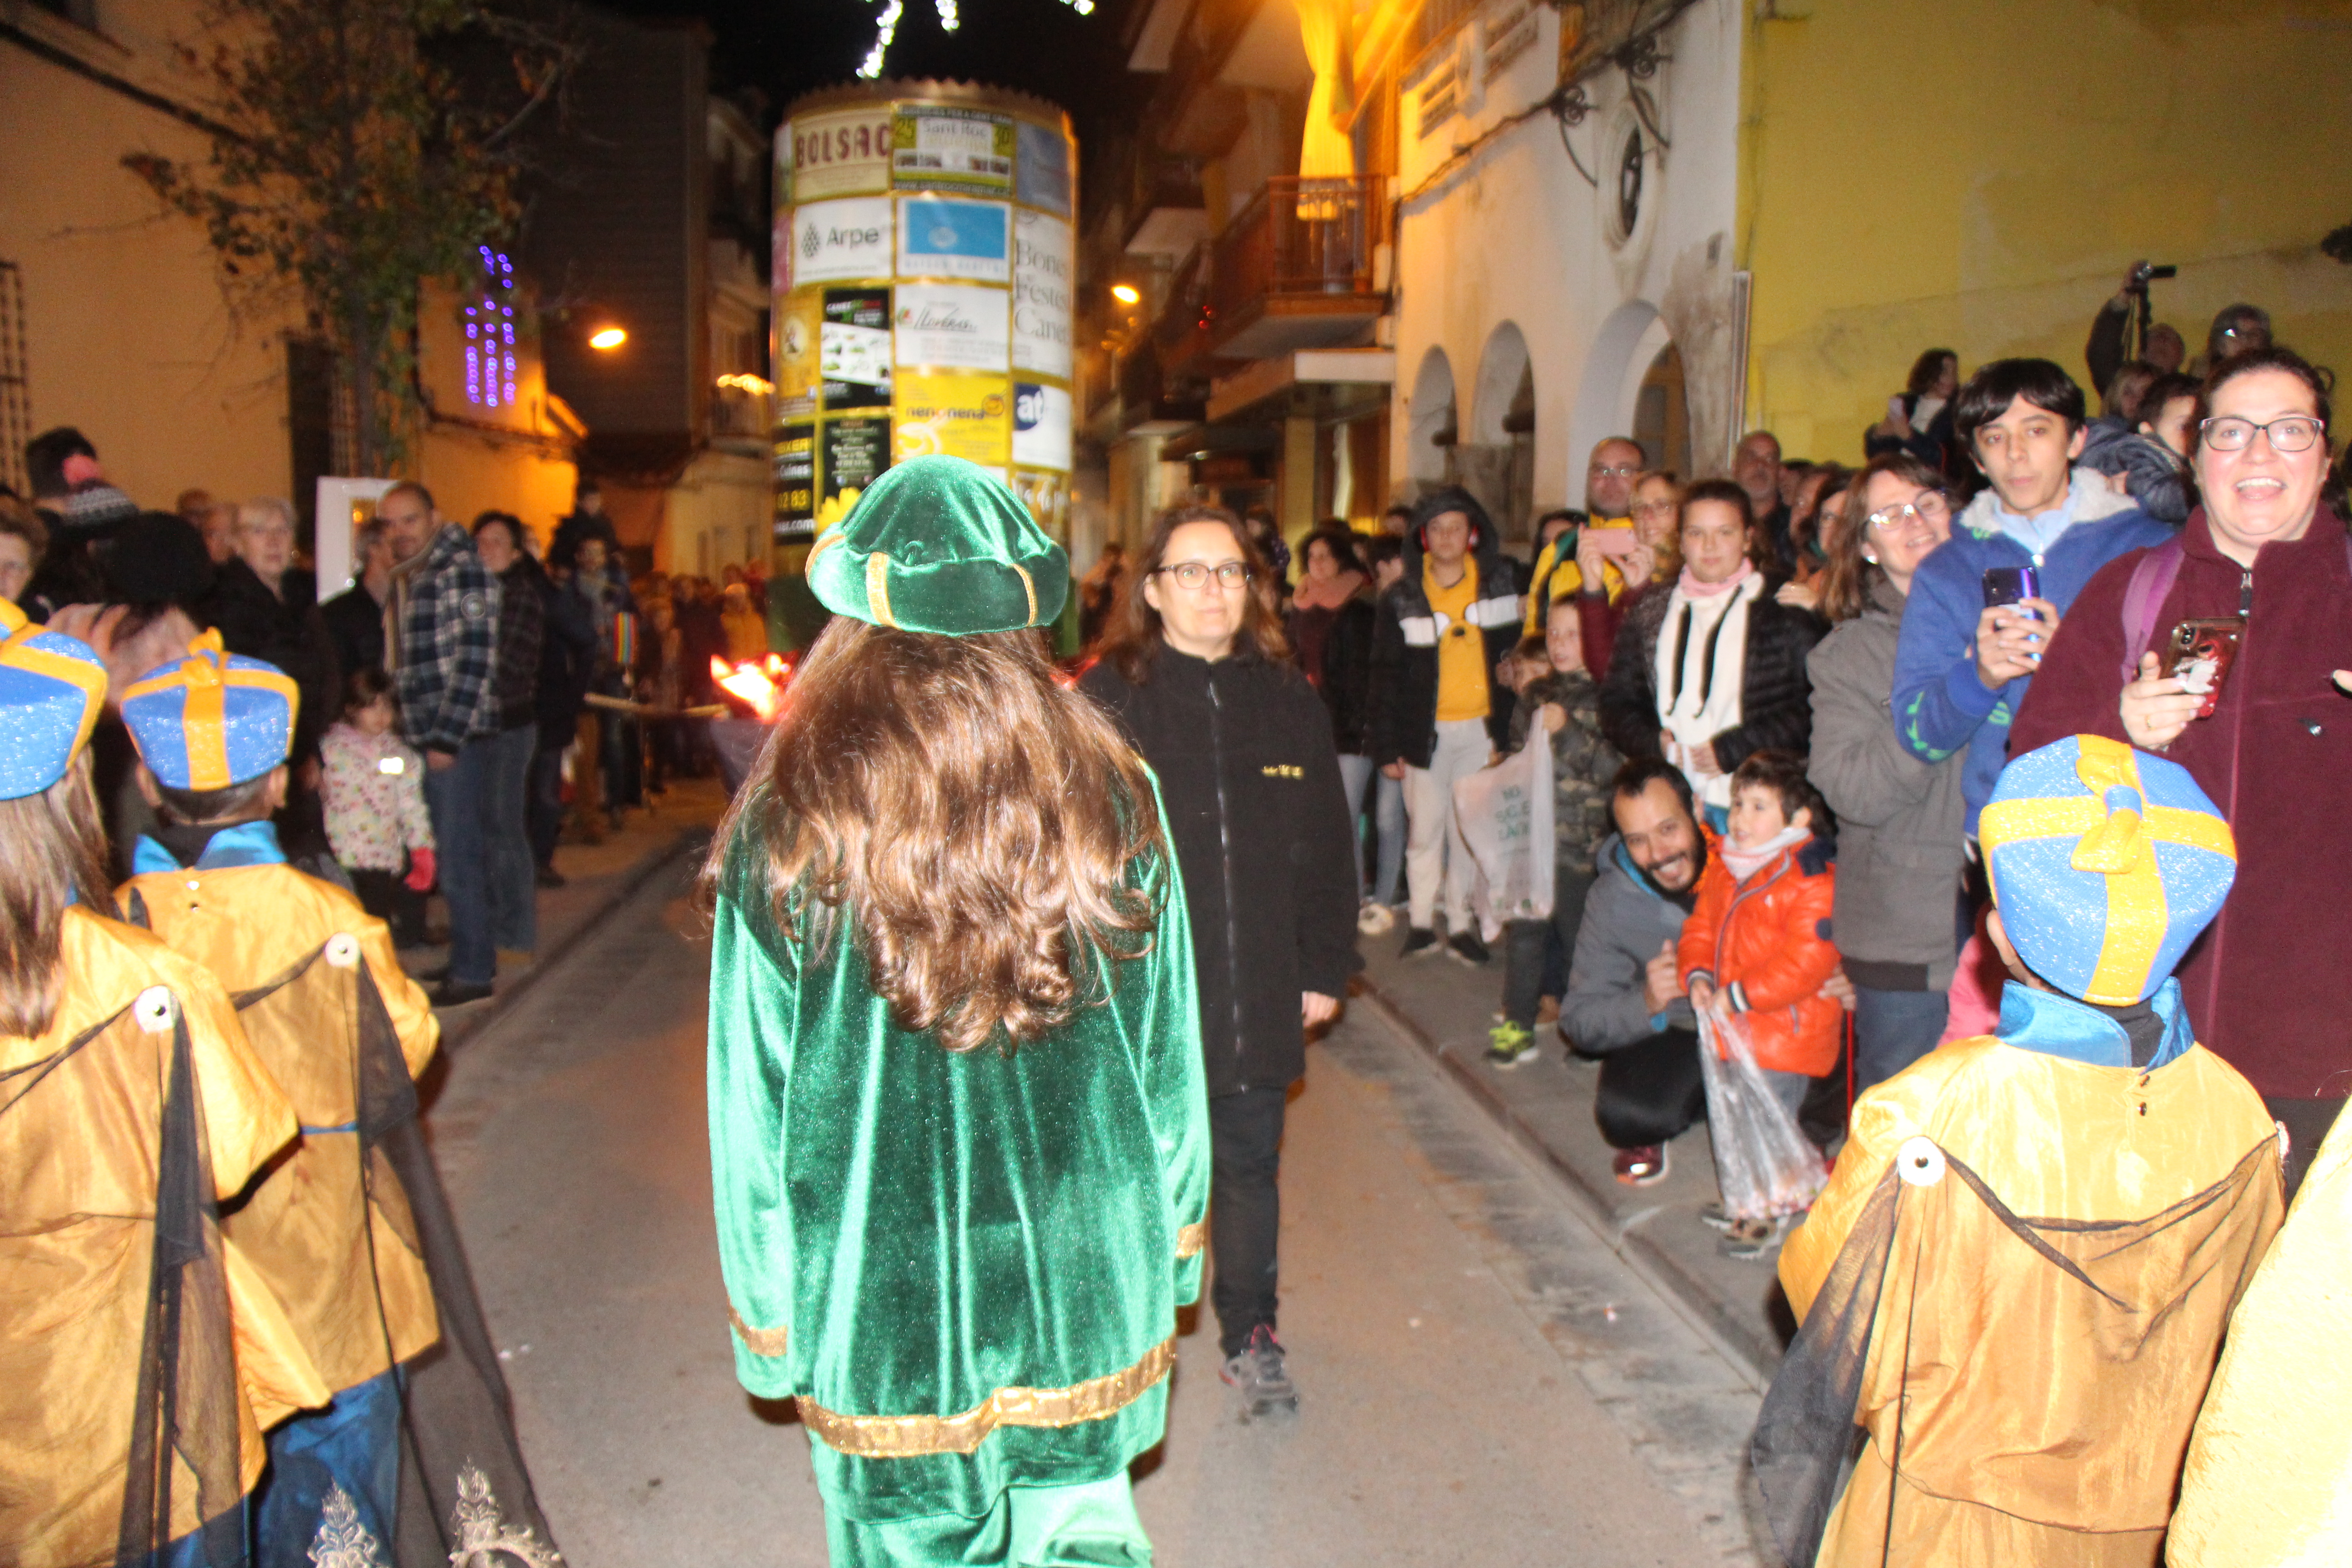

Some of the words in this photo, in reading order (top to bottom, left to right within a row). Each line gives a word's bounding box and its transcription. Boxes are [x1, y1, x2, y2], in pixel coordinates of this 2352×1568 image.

[922, 120, 956, 134] Sant
[961, 121, 988, 137] Roc
[827, 227, 879, 249] Arpe
[791, 489, 807, 509] 83
